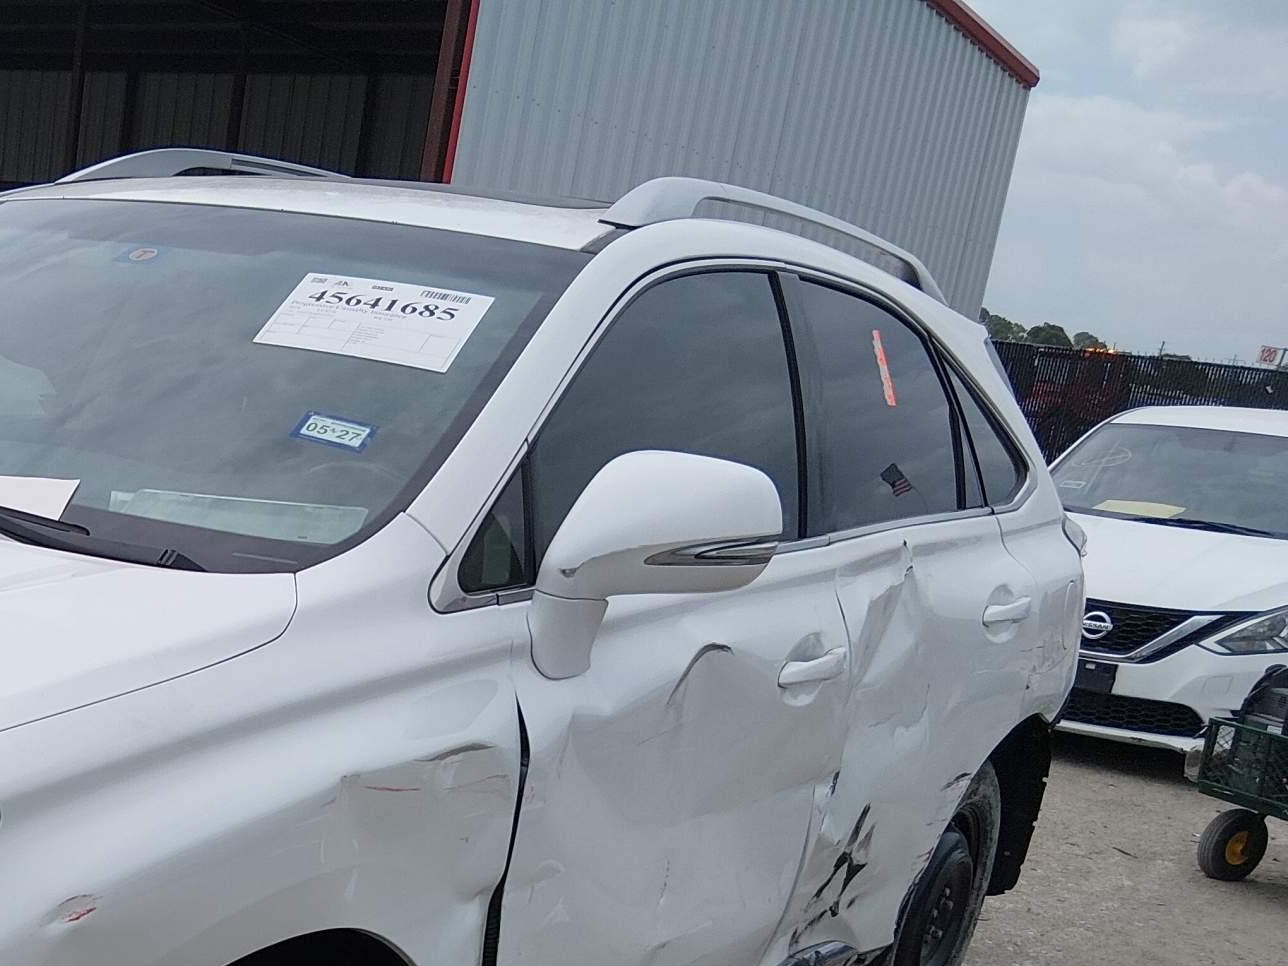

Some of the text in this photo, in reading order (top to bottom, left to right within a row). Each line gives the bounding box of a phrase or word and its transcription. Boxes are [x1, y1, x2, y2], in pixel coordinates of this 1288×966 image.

[309, 290, 459, 321] 45641685
[306, 422, 330, 435] 05
[336, 429, 361, 442] 27
